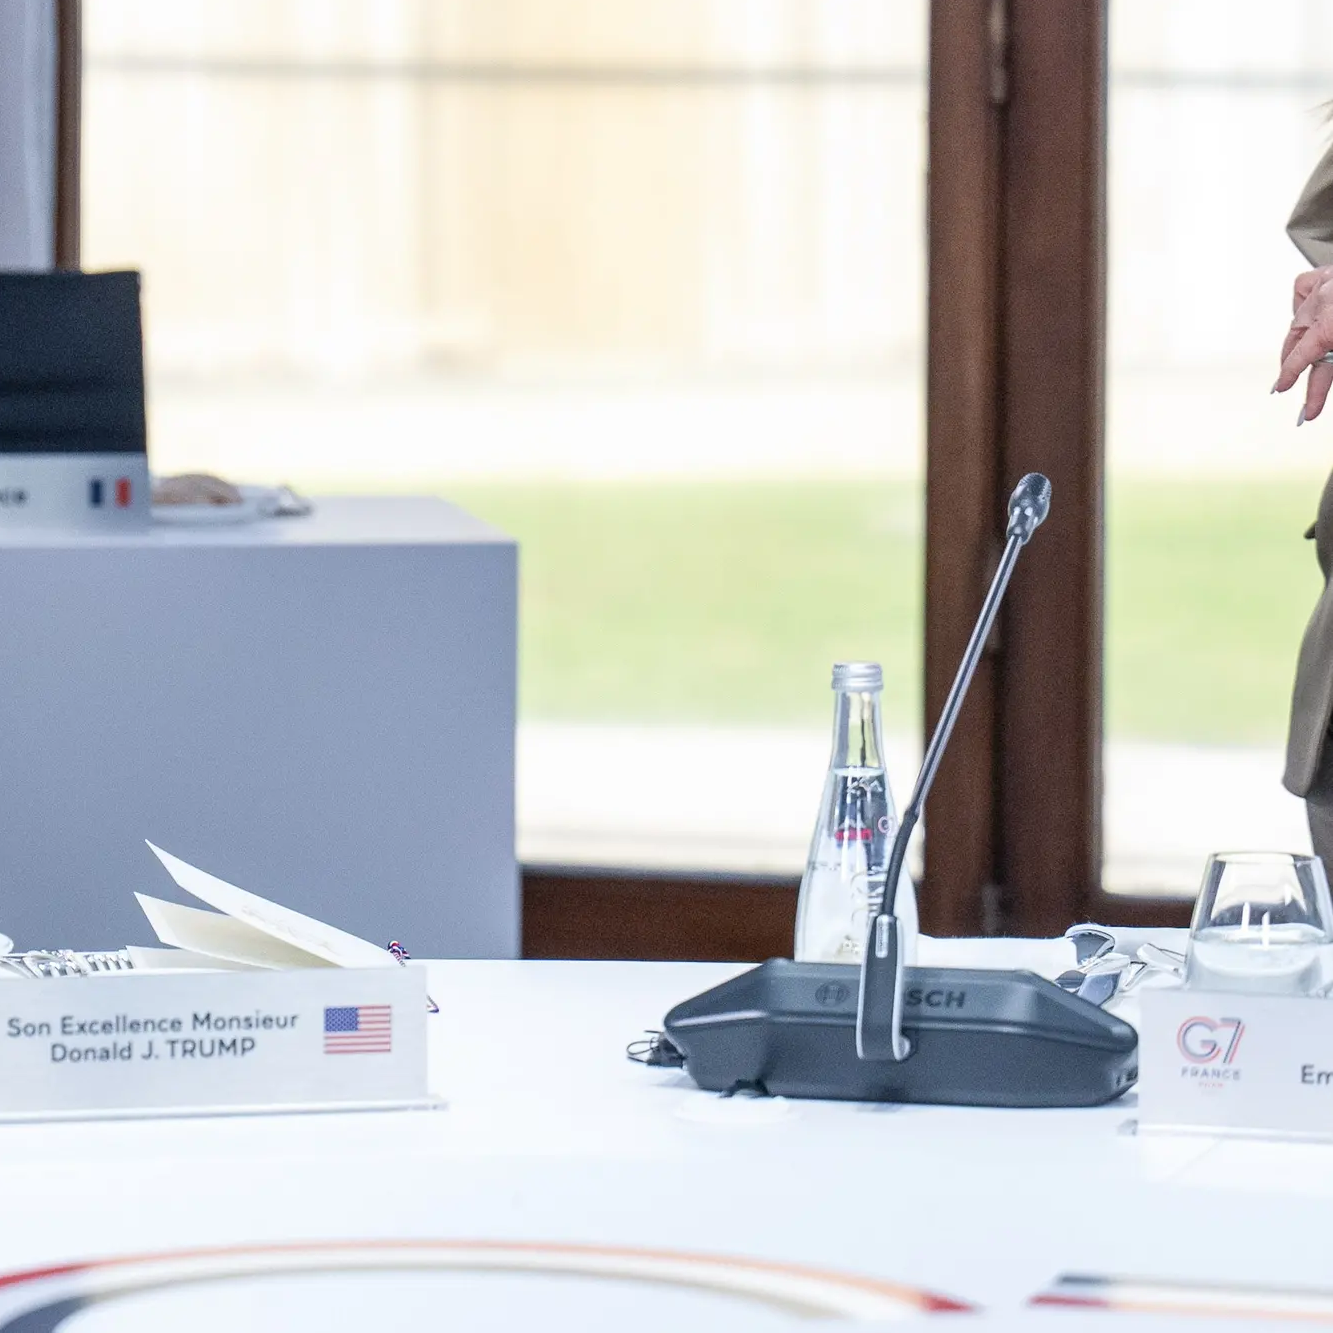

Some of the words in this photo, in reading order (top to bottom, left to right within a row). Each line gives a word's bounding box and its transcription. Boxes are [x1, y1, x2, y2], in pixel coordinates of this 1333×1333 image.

[905, 989, 966, 1008] SCH
[7, 1018, 51, 1037] Son
[61, 1015, 182, 1036] Excellence
[192, 1010, 299, 1031] Monsieur
[51, 1042, 132, 1062] Donald
[141, 1041, 160, 1060] J.
[167, 1038, 255, 1058] TRUMP
[1176, 1015, 1245, 1064] G7
[1180, 1066, 1241, 1081] FRANCE
